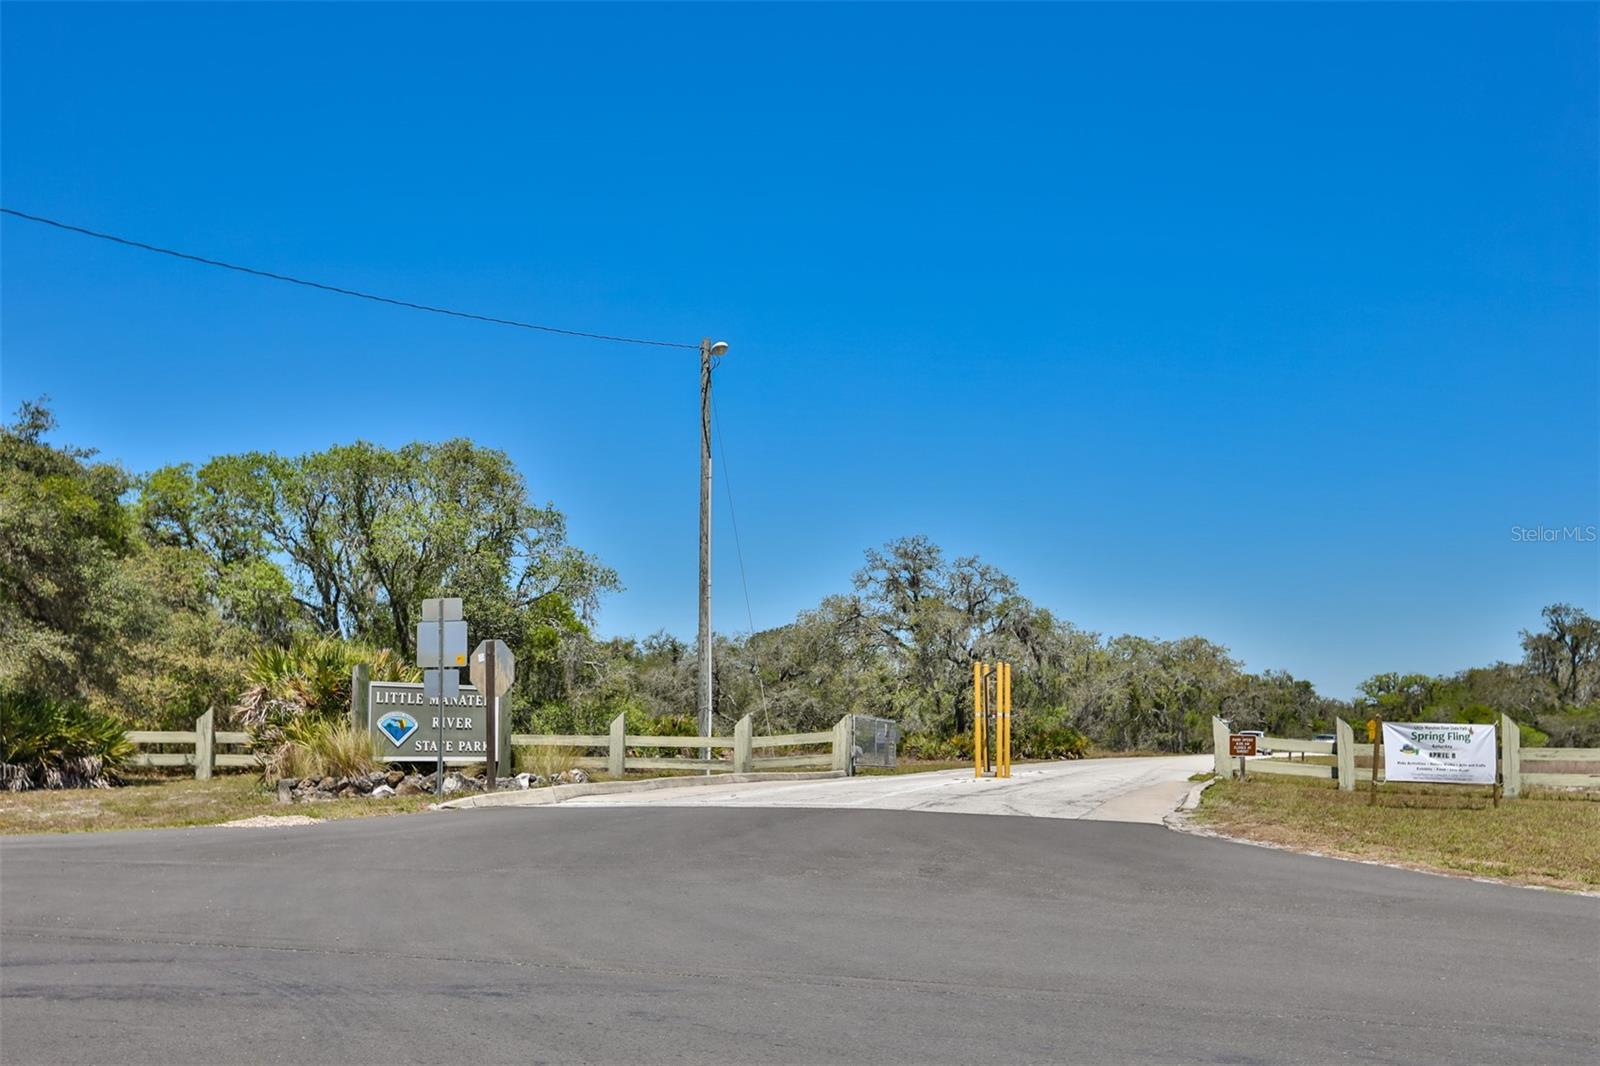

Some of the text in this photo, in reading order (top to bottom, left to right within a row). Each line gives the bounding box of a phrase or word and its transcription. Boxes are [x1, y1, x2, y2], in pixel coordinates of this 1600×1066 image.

[376, 691, 424, 704] LITTLE
[432, 717, 473, 729] RIVER
[1411, 731, 1471, 744] Spring Fling
